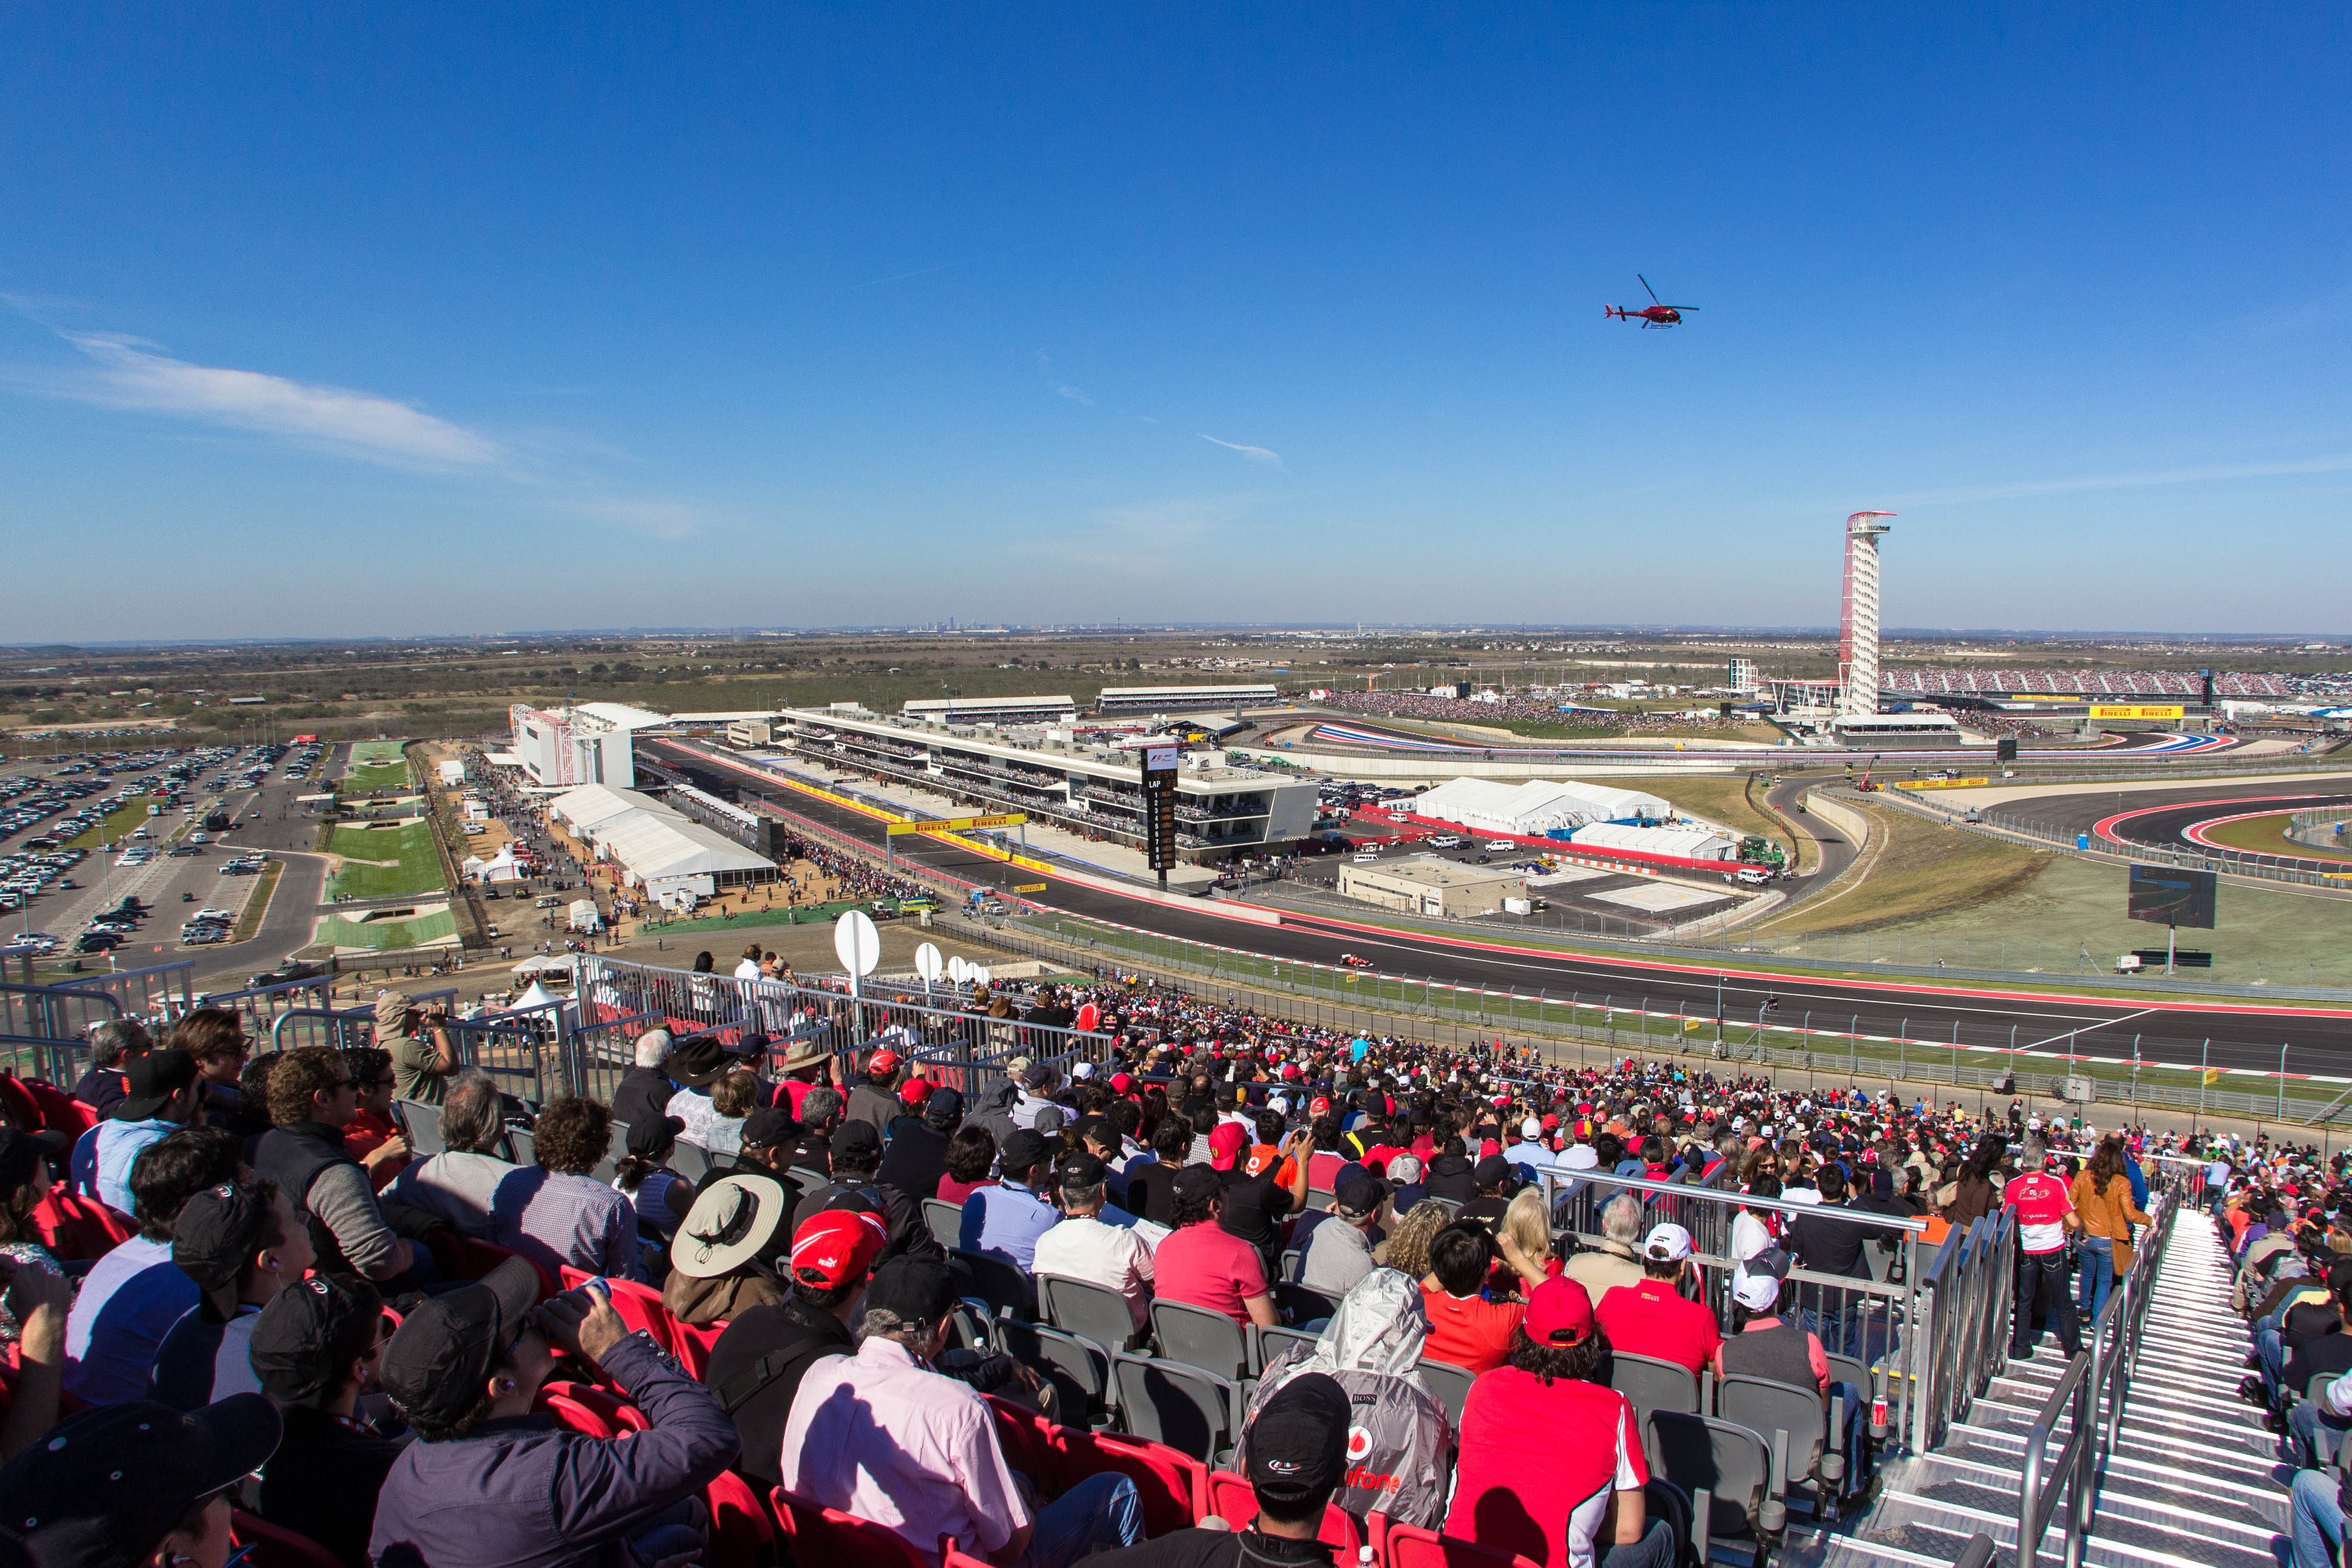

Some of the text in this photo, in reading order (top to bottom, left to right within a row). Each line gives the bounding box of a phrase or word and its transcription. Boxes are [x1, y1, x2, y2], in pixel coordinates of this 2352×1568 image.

[2100, 708, 2172, 716] PIRELLI PIRELLI
[915, 817, 1006, 832] PIRELLI PIRELLI
